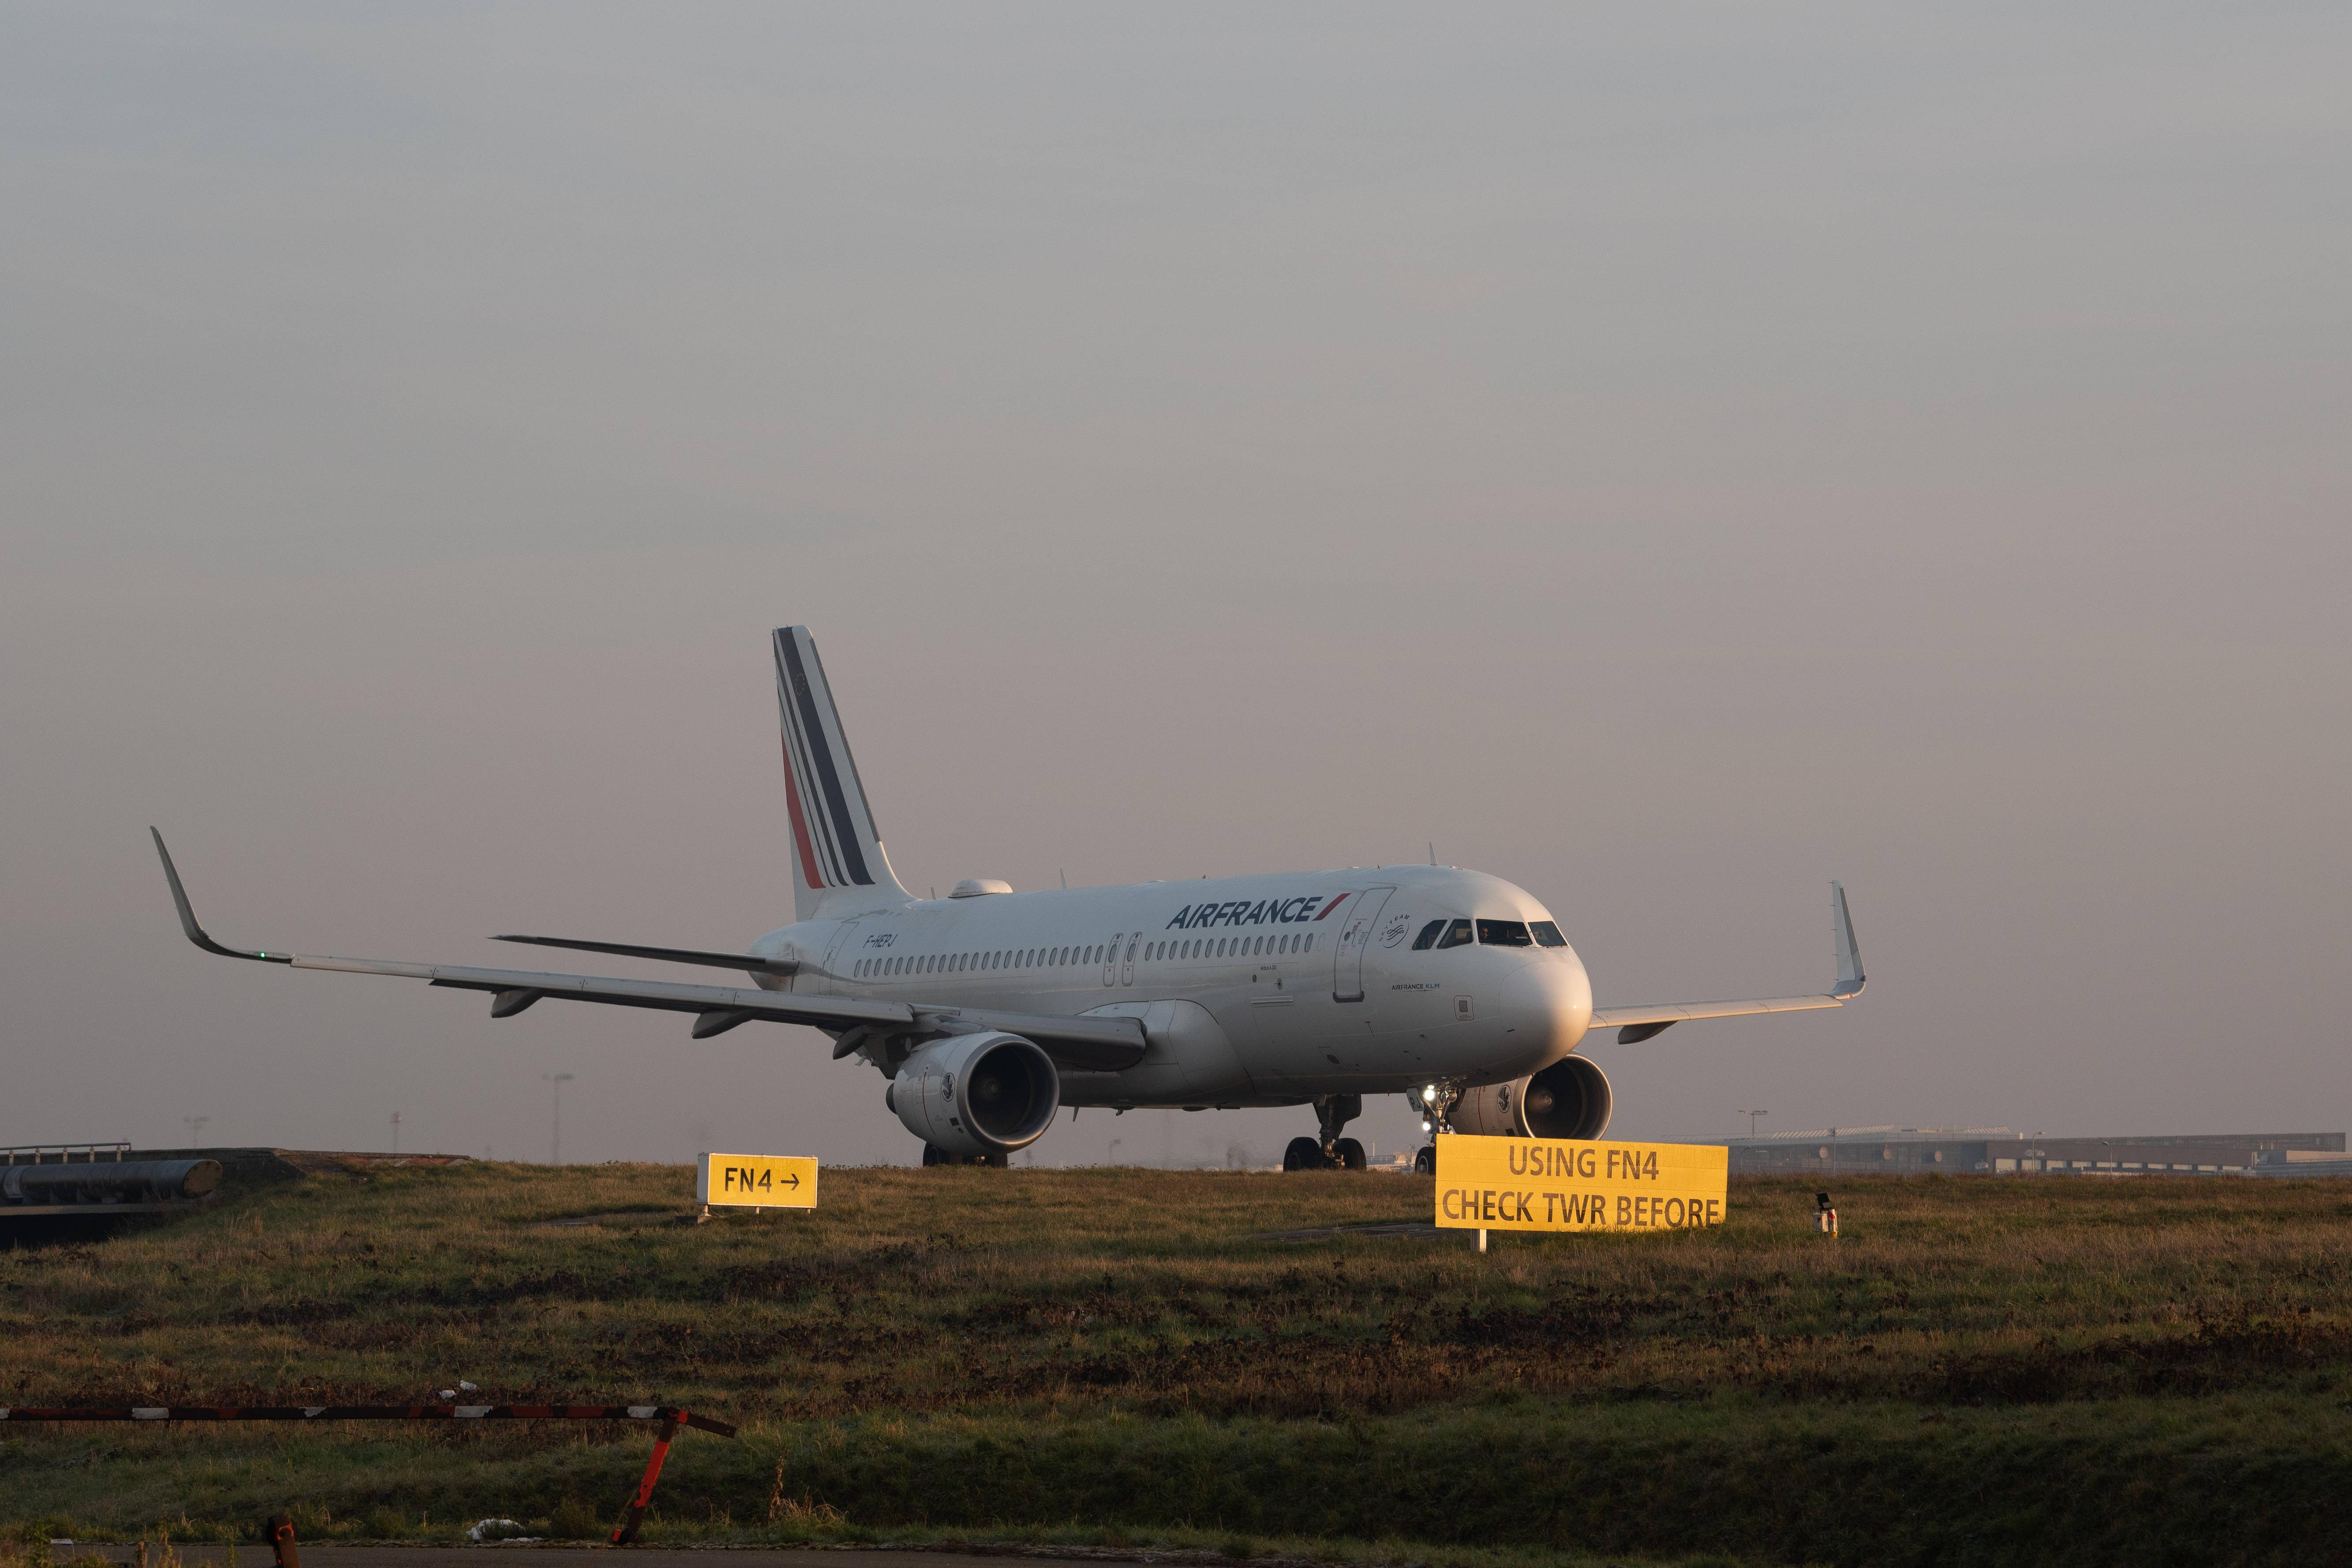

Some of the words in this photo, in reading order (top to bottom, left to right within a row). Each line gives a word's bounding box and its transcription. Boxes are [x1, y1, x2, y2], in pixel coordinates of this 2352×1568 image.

[1165, 896, 1323, 929] AIRFRANCE
[863, 934, 898, 948] F-HEPJ
[1409, 1097, 1421, 1109] PJ
[1509, 1145, 1596, 1178] USING
[1607, 1149, 1659, 1180] FN4
[725, 1167, 772, 1193] FN4
[1443, 1189, 1534, 1222] CHECK
[1542, 1192, 1606, 1225] TWR
[1616, 1196, 1719, 1227] BEFORE
